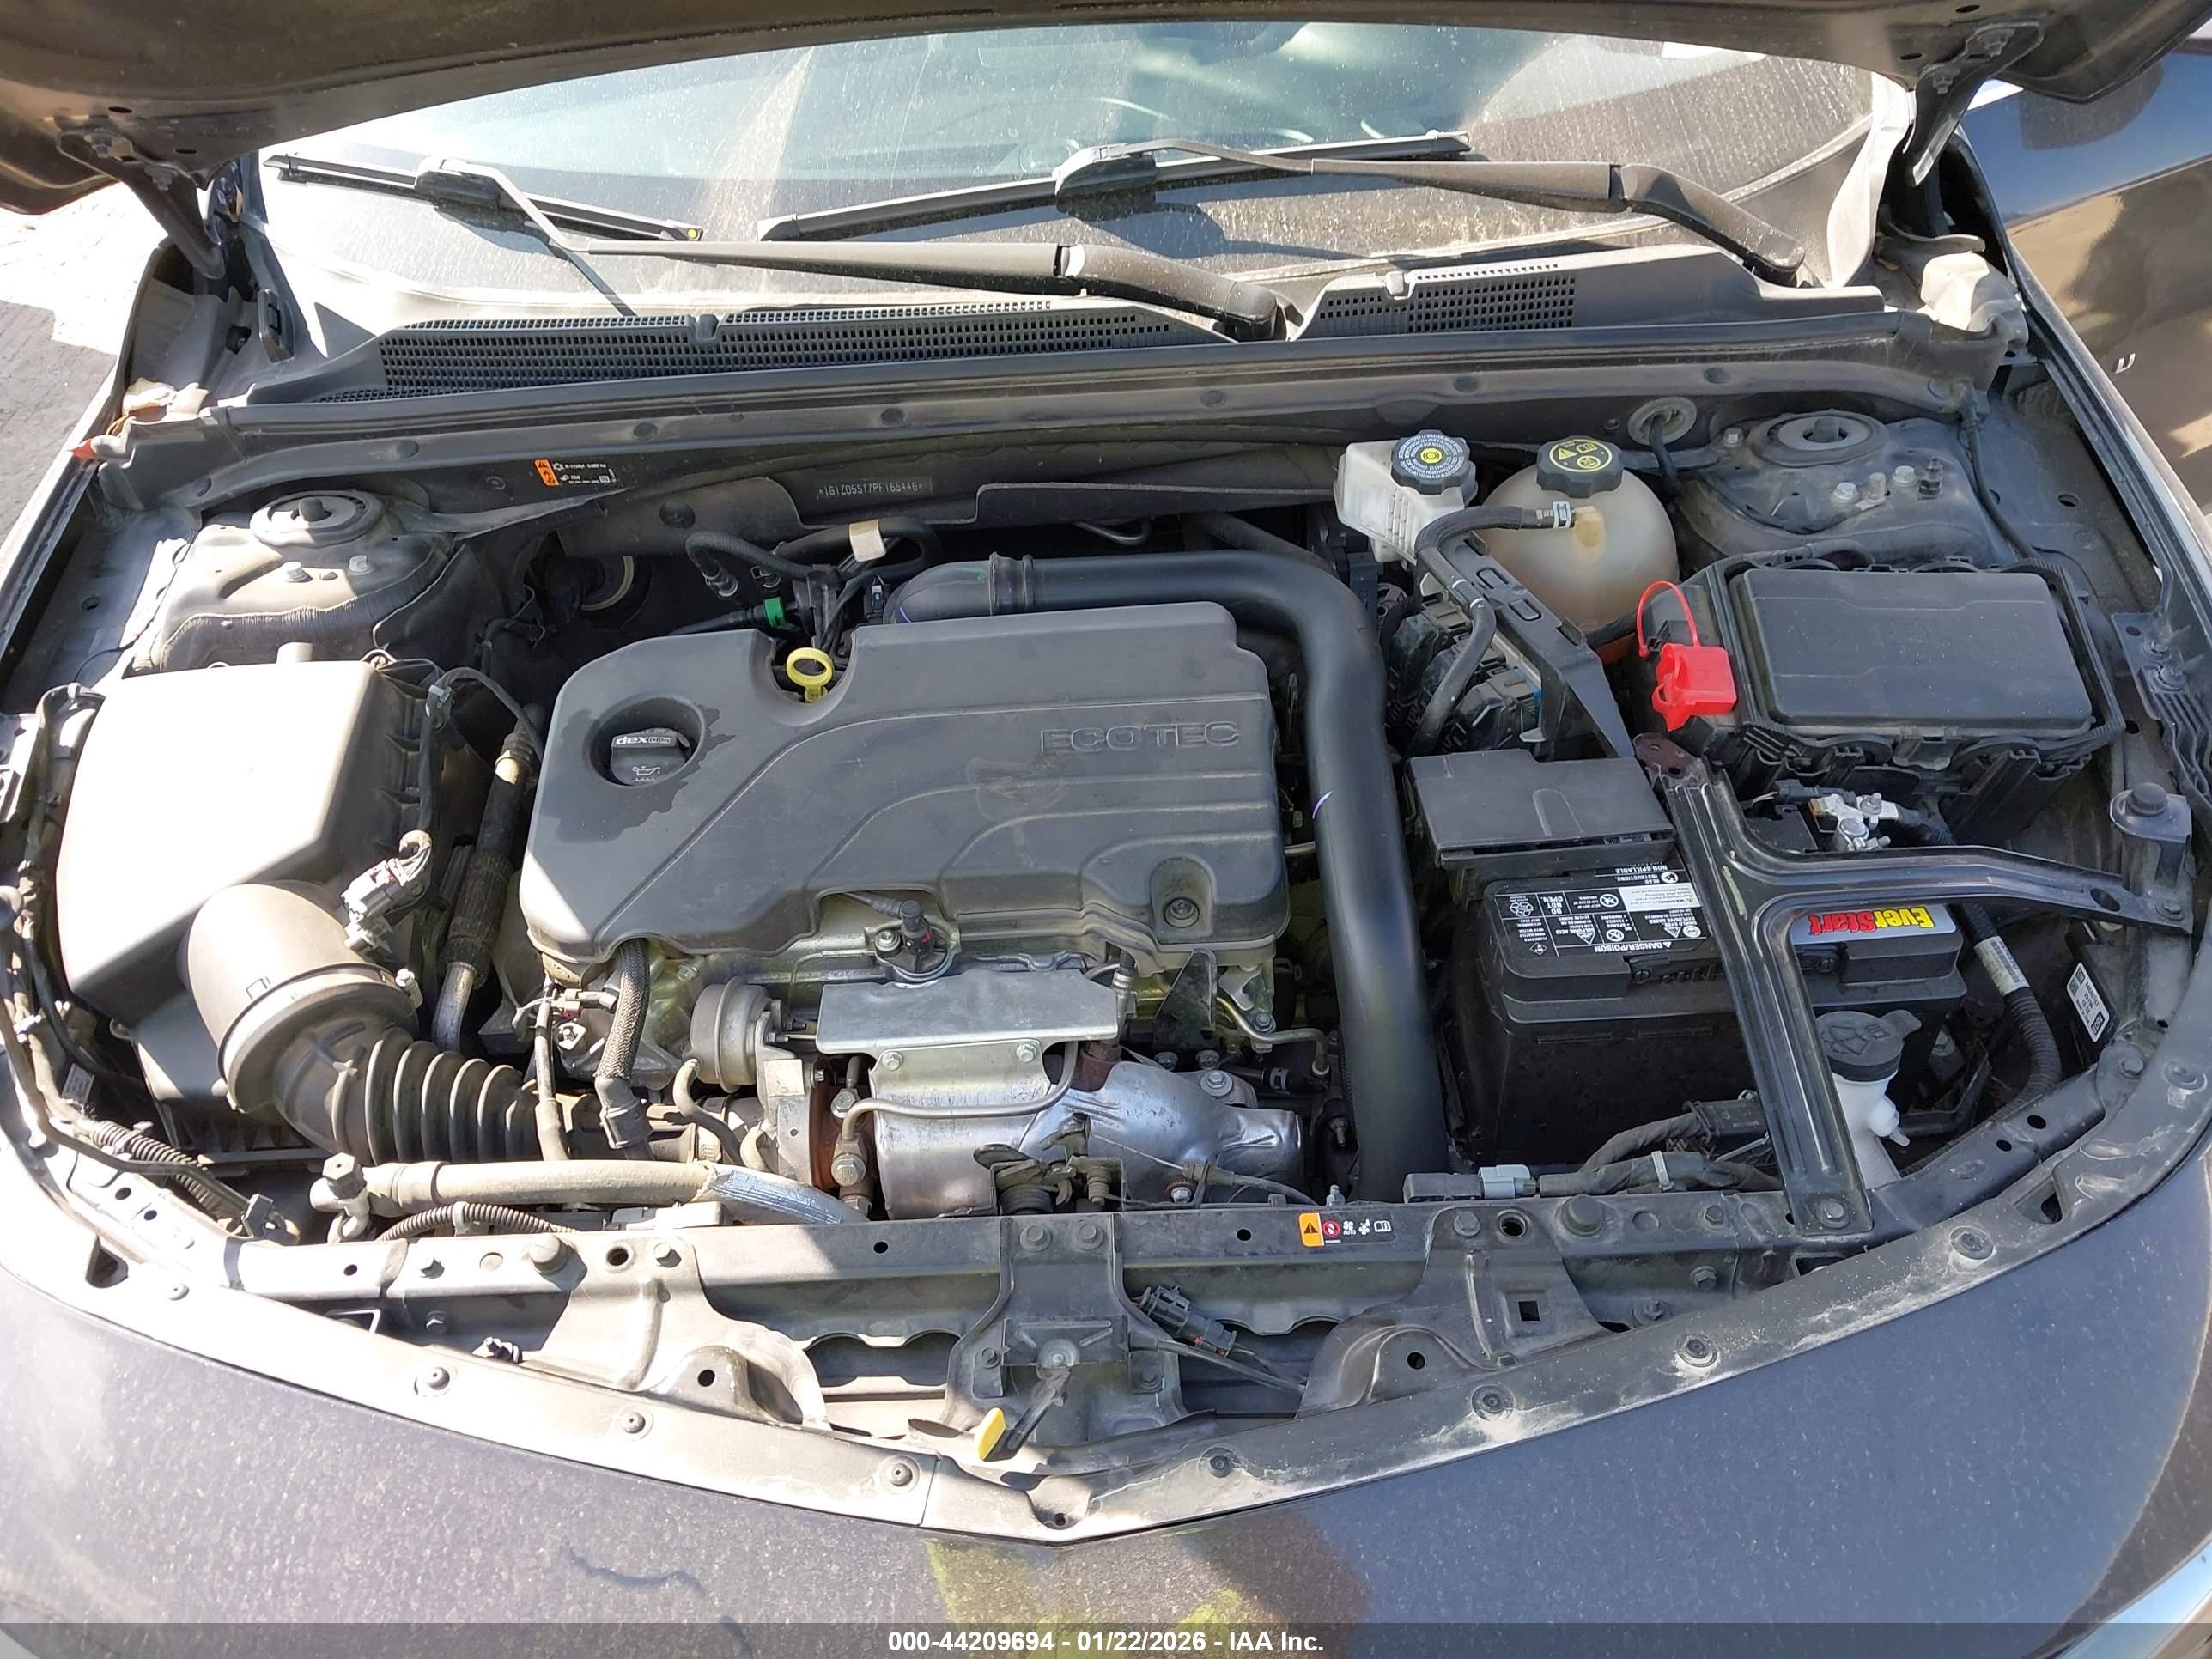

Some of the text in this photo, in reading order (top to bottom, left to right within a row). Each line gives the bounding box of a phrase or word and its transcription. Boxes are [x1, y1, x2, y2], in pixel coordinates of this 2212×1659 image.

[616, 736, 672, 745] dexos
[1040, 721, 1240, 752] ECOTEC
[1808, 905, 1936, 936] EverStart
[1594, 942, 1663, 953] DANGER/POISON
